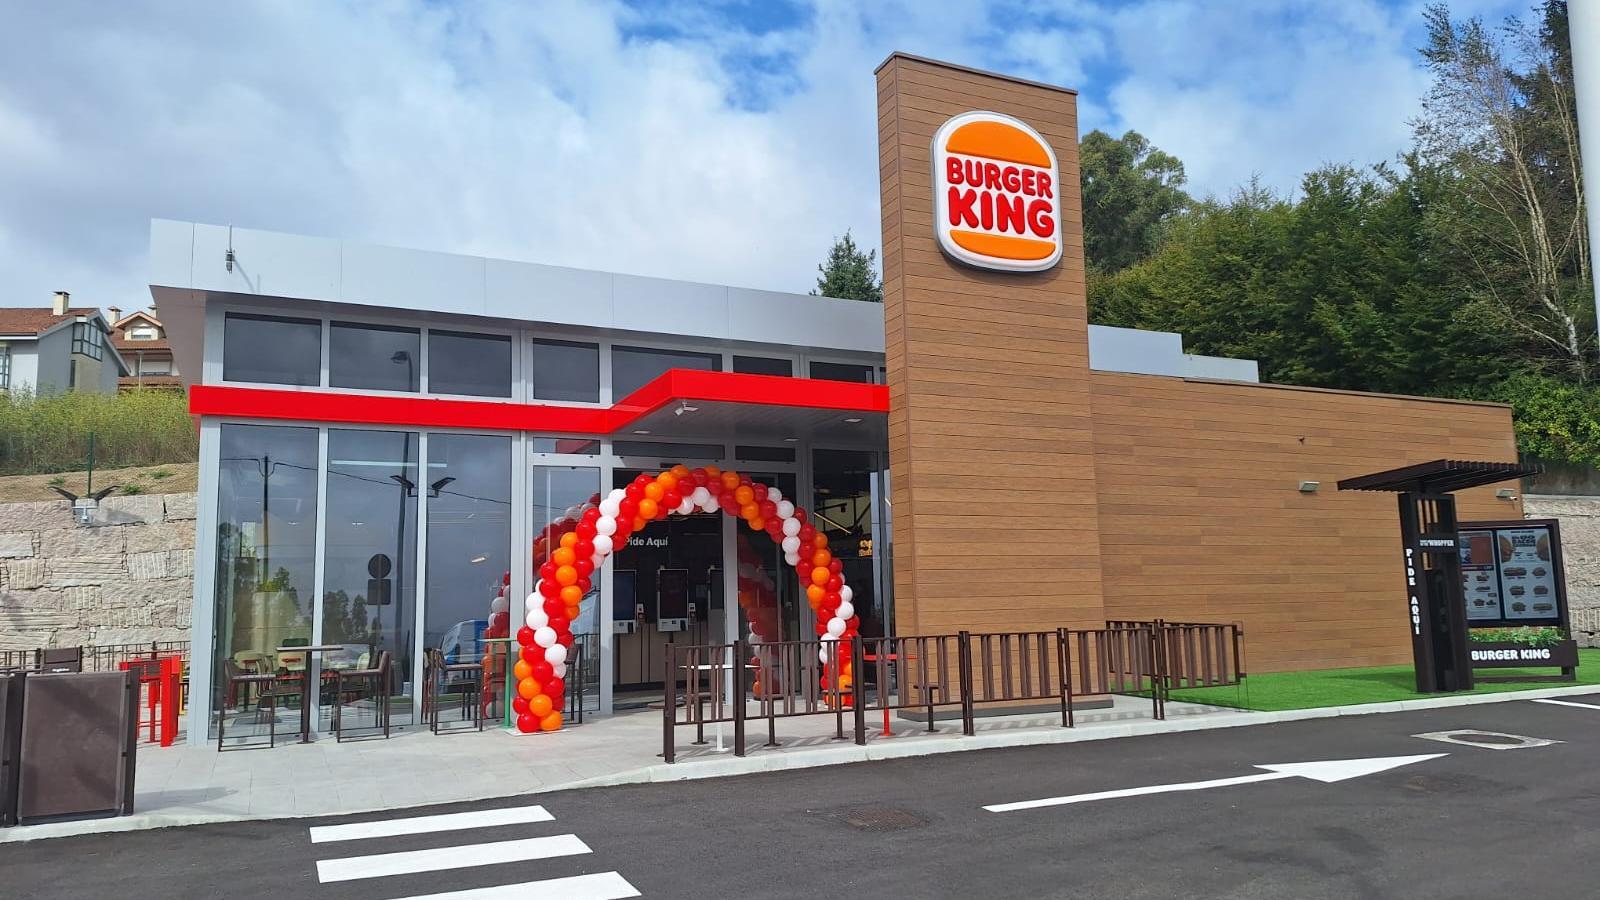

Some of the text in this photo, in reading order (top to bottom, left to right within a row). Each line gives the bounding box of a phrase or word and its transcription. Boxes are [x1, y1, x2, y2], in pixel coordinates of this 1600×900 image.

[946, 156, 1053, 199] BURGER
[948, 186, 1055, 238] KING
[646, 536, 668, 548] Aquí
[1406, 548, 1416, 586] PIDE
[1471, 648, 1551, 660] BURGER KING
